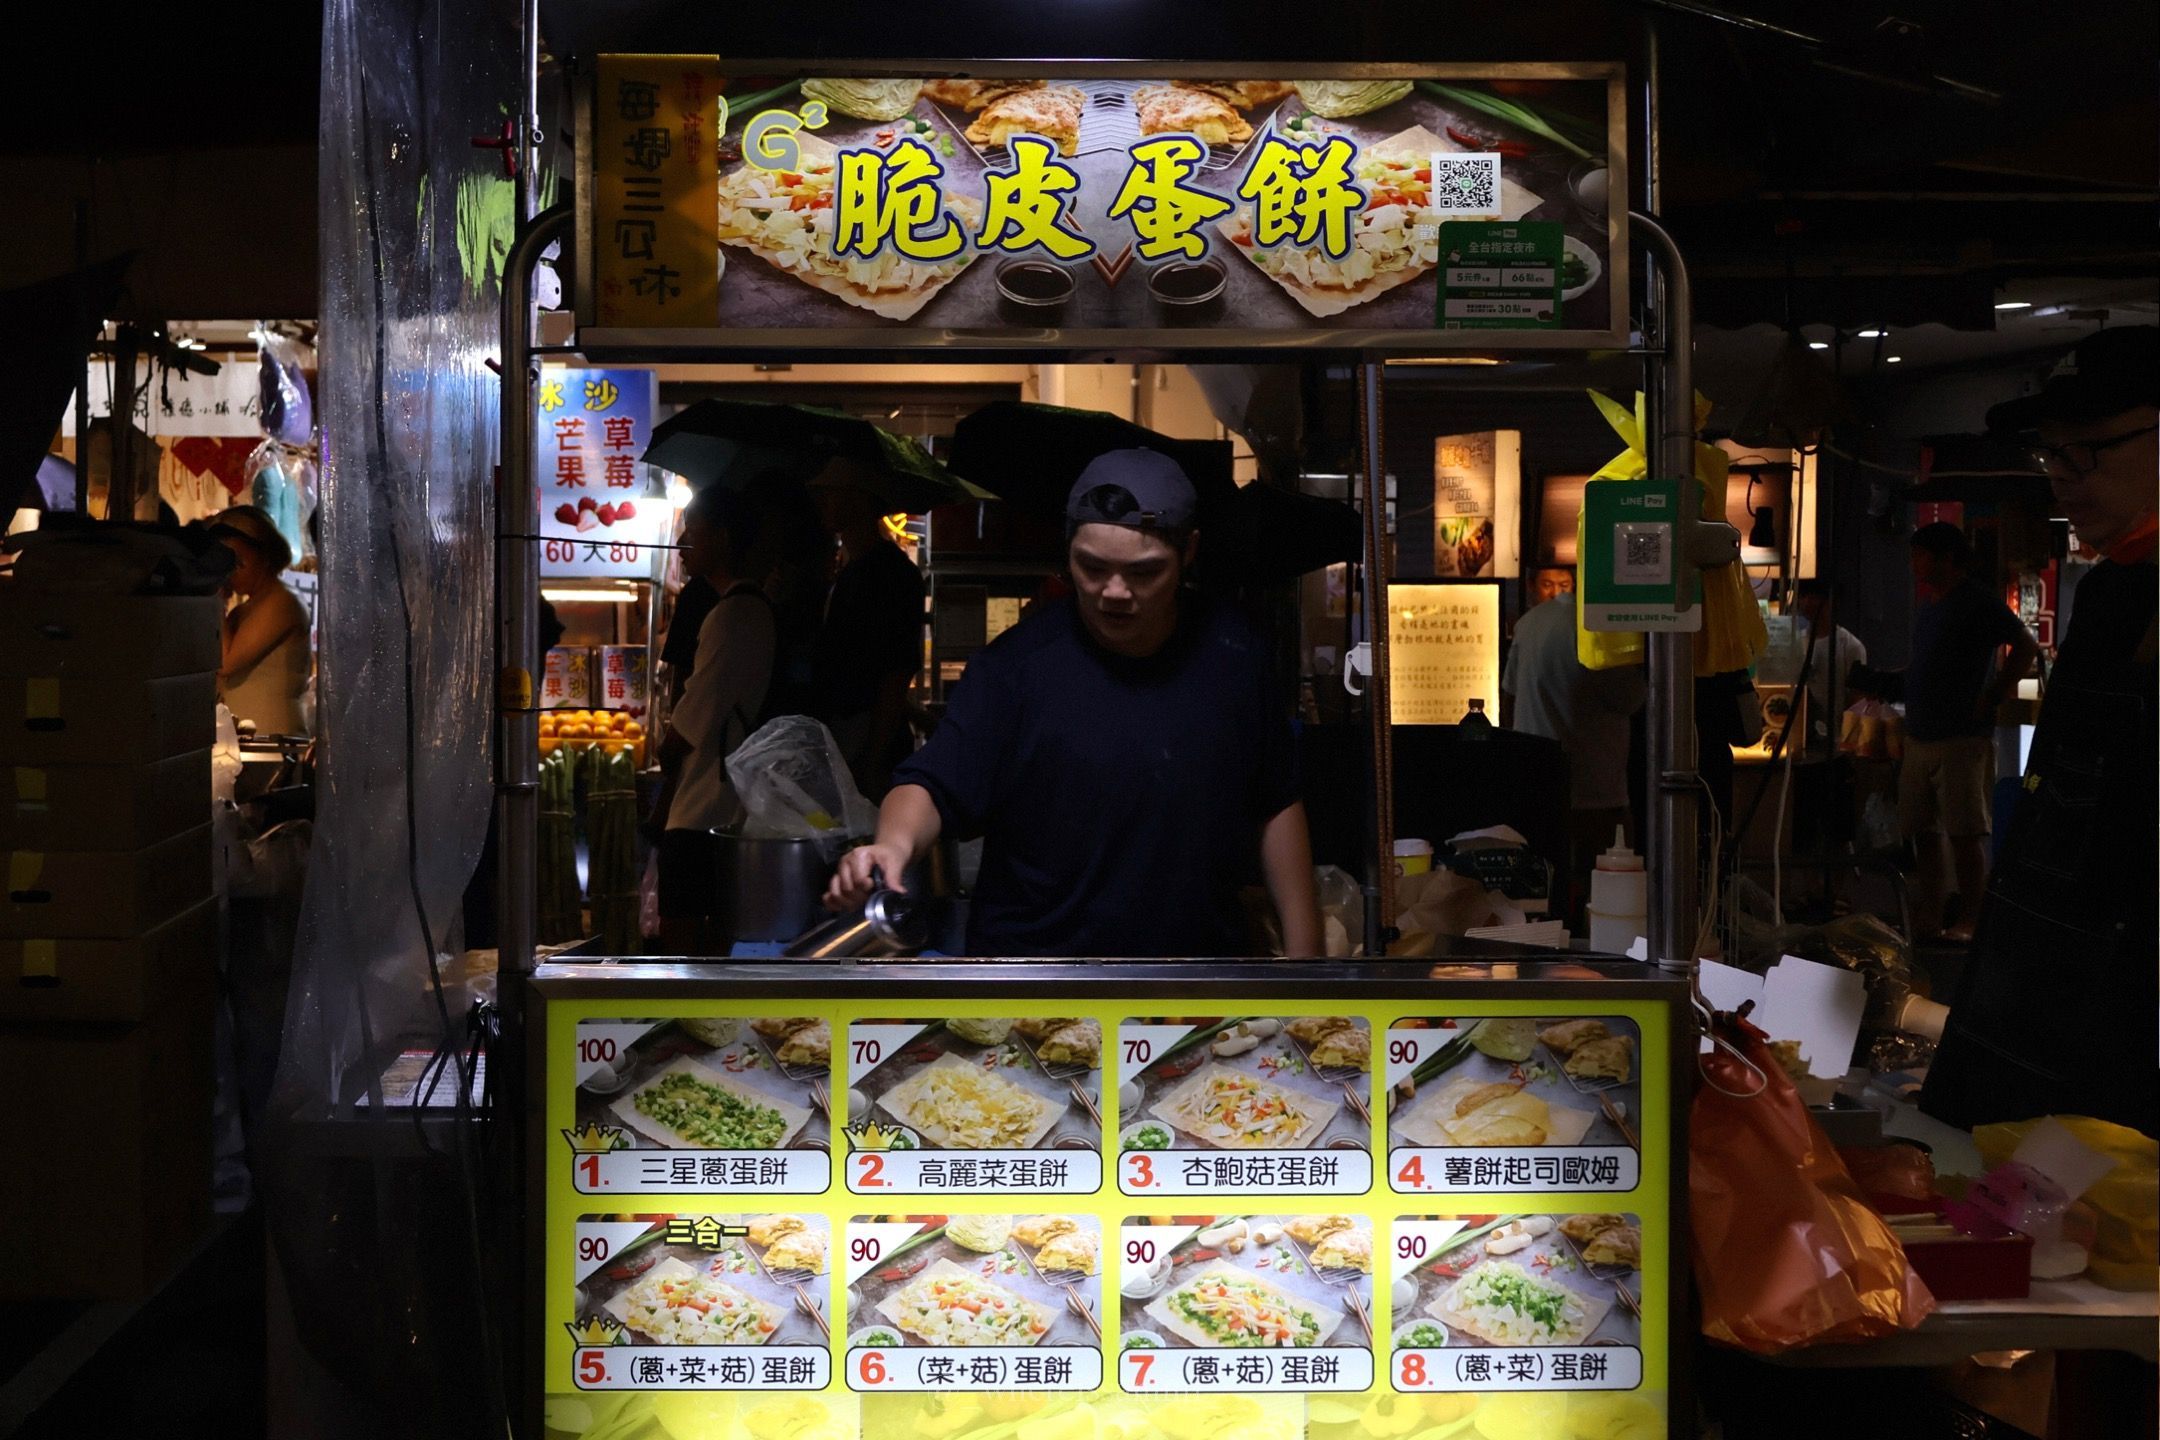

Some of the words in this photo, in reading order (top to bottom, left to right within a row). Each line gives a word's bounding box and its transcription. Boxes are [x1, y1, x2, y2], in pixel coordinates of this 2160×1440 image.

[835, 135, 1363, 262] 脆皮蛋餅
[1468, 242, 1536, 254] 全台指定夜市
[555, 417, 587, 489] 芒果
[603, 416, 635, 489] 草莓
[1620, 497, 1643, 506] LINE
[545, 540, 575, 563] 60
[583, 541, 606, 562] 大
[609, 540, 638, 563] 80
[545, 654, 563, 698] 芒果
[568, 654, 586, 699] 冰沙
[607, 654, 625, 699] 草莓
[578, 1039, 616, 1063] 100
[851, 1041, 881, 1064] 70
[1123, 1041, 1151, 1064] 70
[1389, 1041, 1418, 1064] 90
[580, 1155, 610, 1187] 1.
[640, 1157, 788, 1186] 三星蔥蛋餅
[857, 1155, 893, 1187] 2.
[918, 1159, 1068, 1188] 高麗菜蛋餅
[1128, 1155, 1161, 1187] 3.
[1182, 1157, 1339, 1187] 杏鮑菇蛋餅
[1398, 1156, 1432, 1189] 4.
[1444, 1156, 1620, 1185] 薯餅起司歐姆
[665, 1217, 749, 1248] 三合一
[1397, 1236, 1427, 1259] 90
[578, 1238, 609, 1261] 90
[851, 1238, 881, 1261] 90
[1126, 1241, 1156, 1264] 90
[579, 1351, 612, 1383] 5.
[859, 1352, 894, 1384] 6.
[1128, 1355, 1155, 1386] 7.
[1400, 1353, 1434, 1386] 8.
